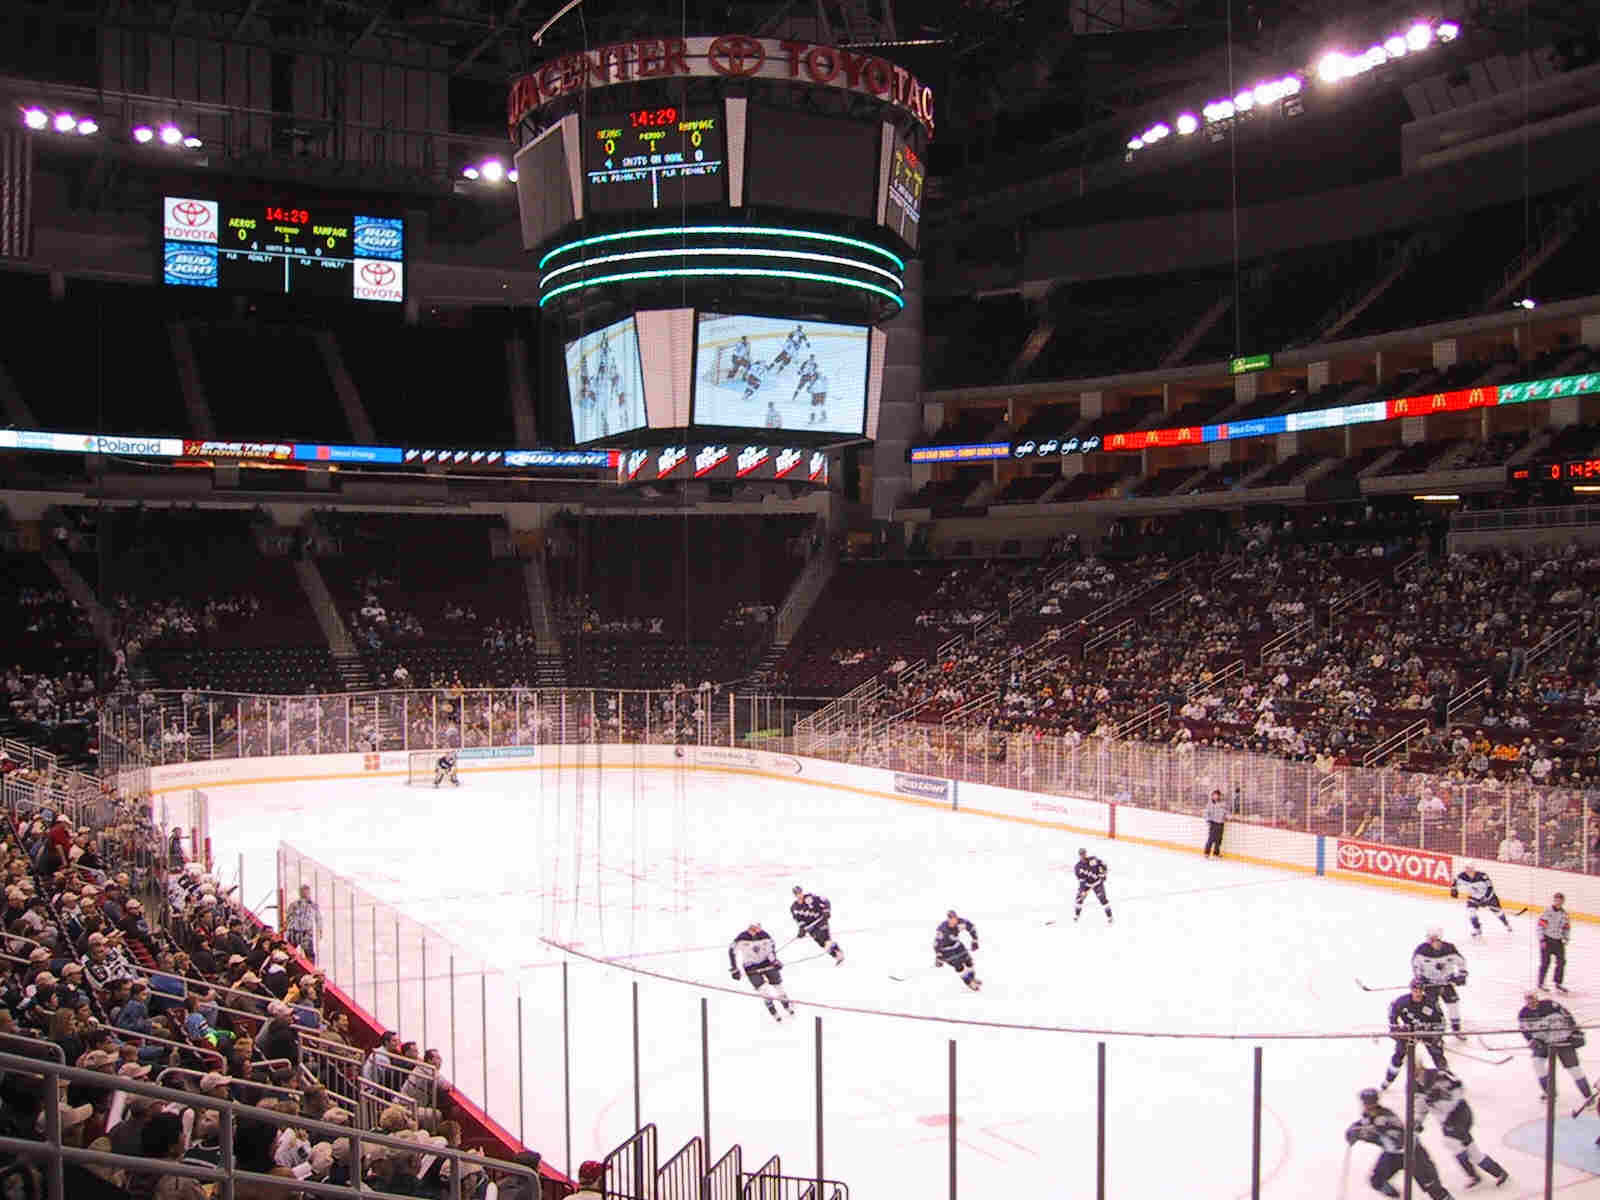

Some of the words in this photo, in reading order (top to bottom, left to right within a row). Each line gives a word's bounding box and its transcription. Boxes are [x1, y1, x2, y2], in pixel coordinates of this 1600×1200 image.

[630, 107, 677, 128] 14:29
[604, 138, 615, 155] 0
[691, 131, 703, 147] 0
[265, 207, 309, 225] 14:29
[165, 226, 218, 241] TOYOTA
[237, 228, 247, 241] 0
[363, 227, 397, 239] BUD
[326, 236, 336, 249] 0
[174, 254, 212, 266] BUD
[355, 287, 402, 298] TOYOTA
[97, 437, 161, 455] Polaroid
[1363, 850, 1451, 882] TOYOTA
